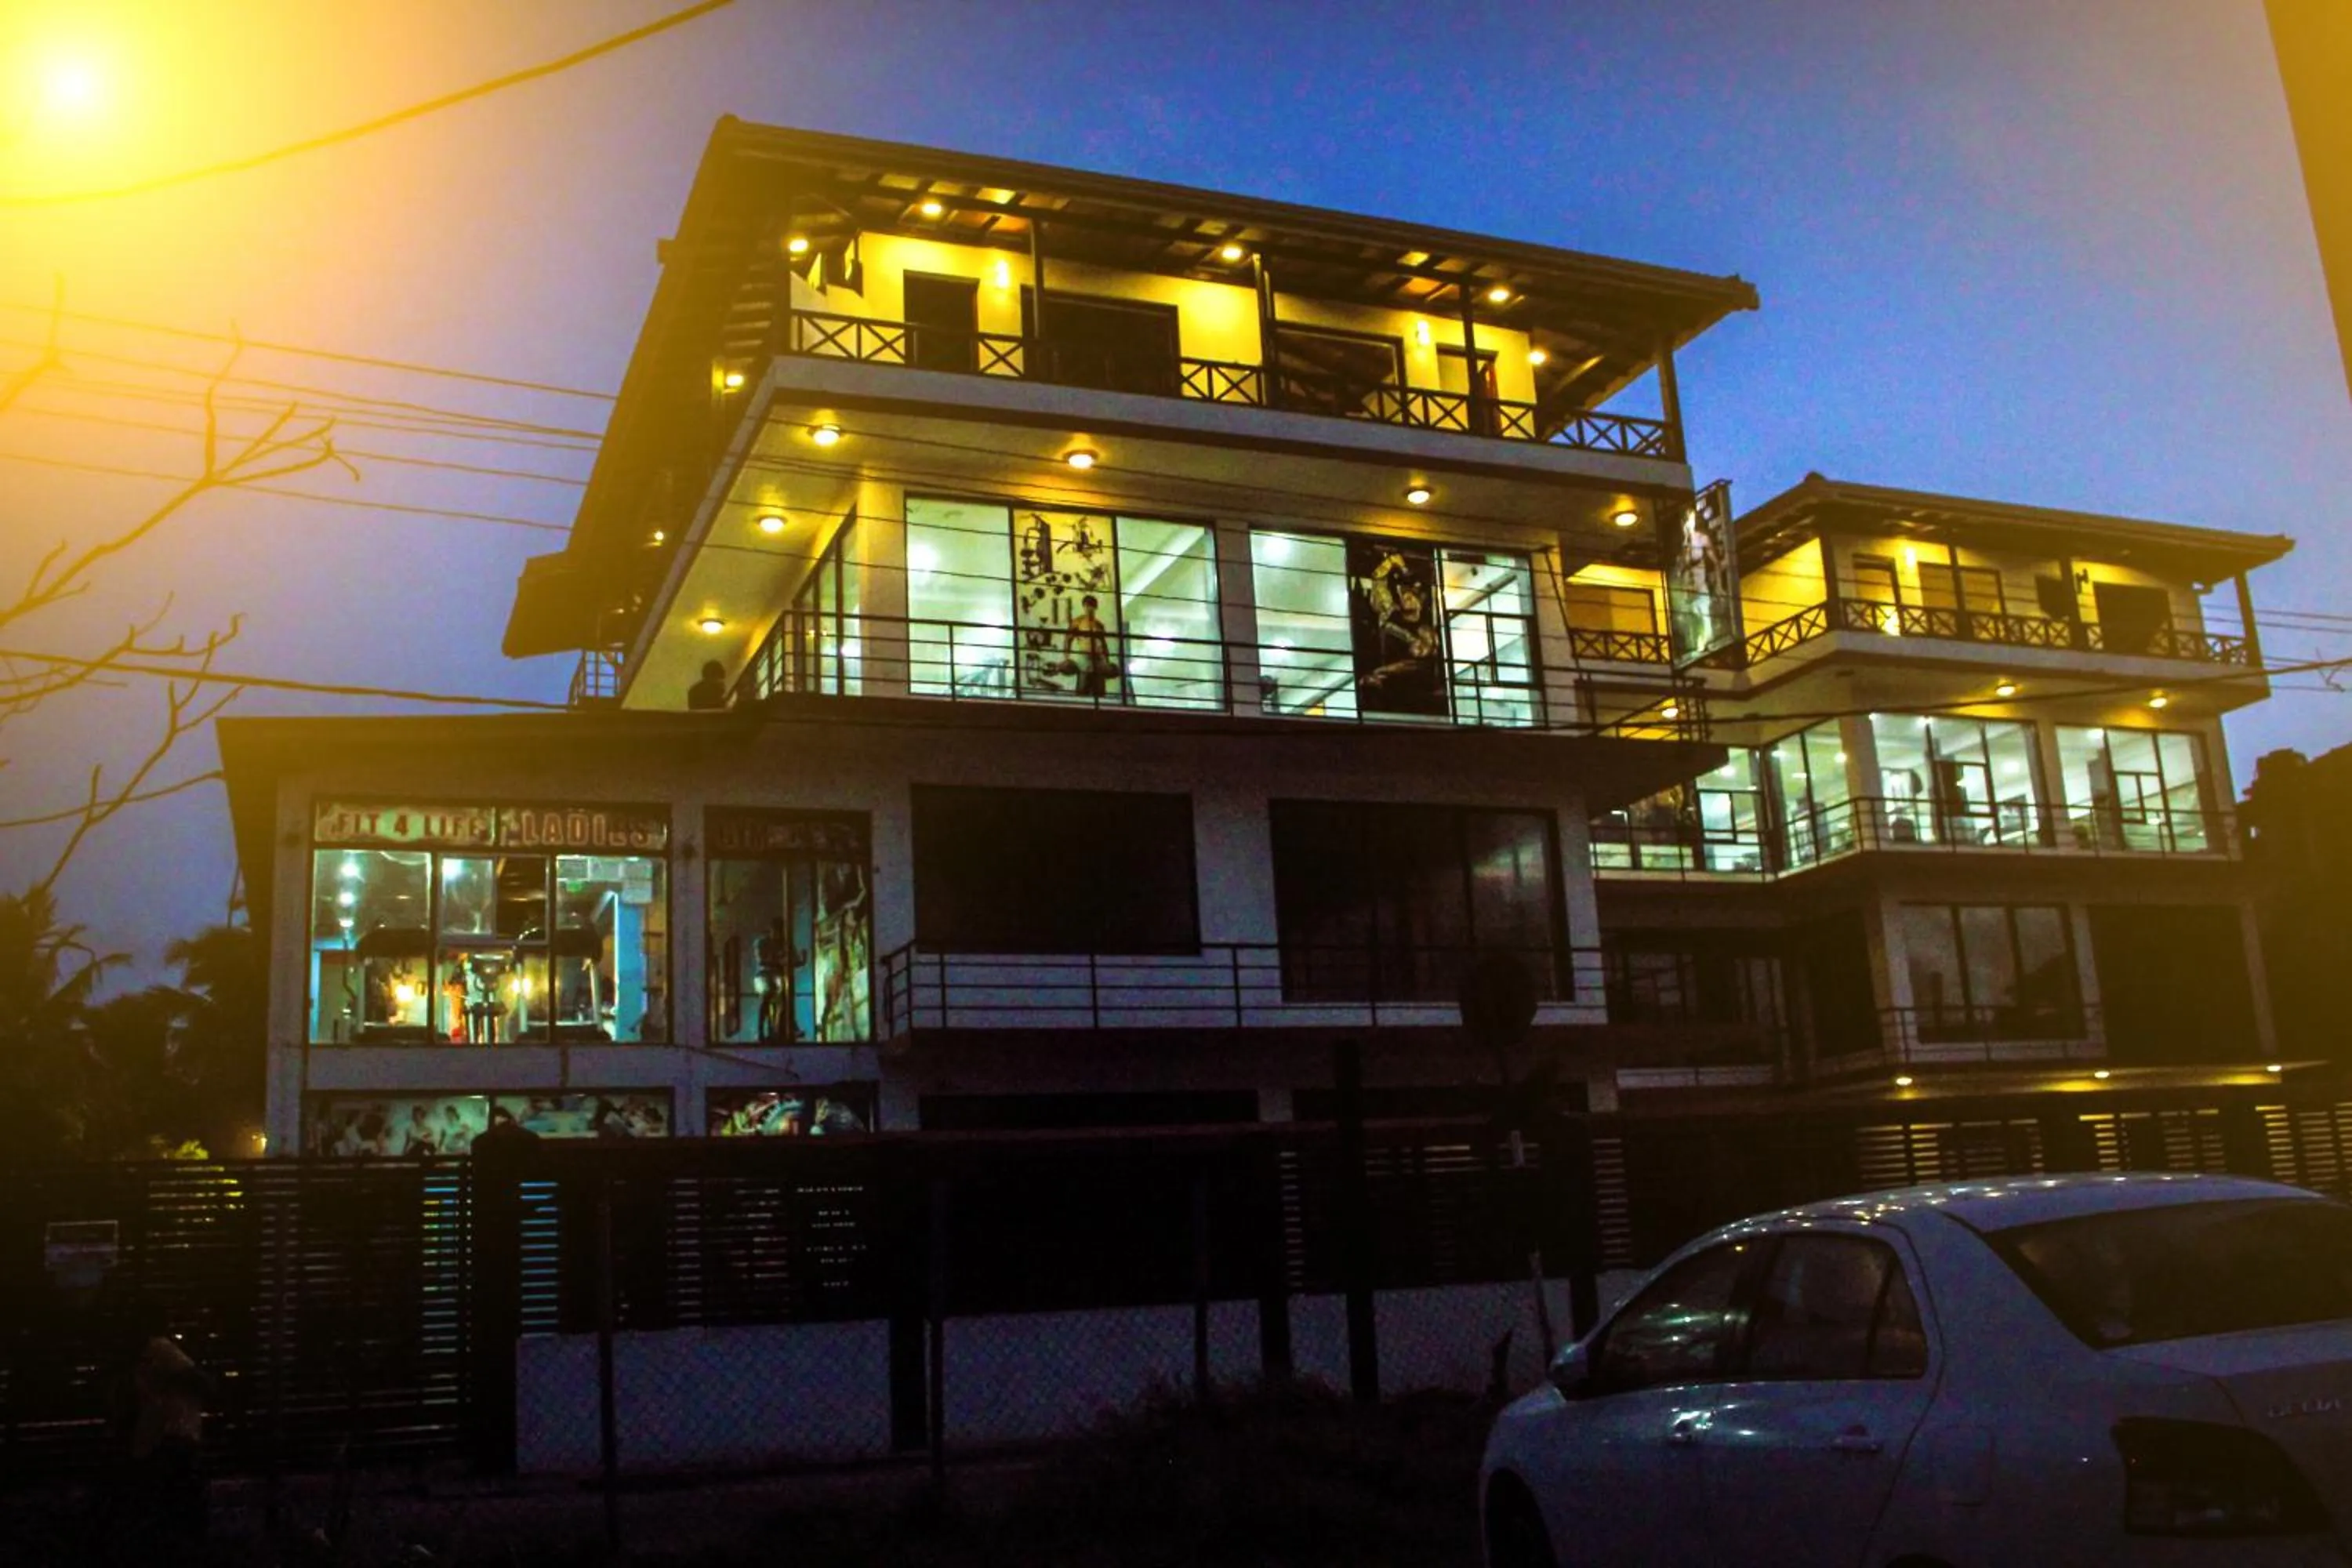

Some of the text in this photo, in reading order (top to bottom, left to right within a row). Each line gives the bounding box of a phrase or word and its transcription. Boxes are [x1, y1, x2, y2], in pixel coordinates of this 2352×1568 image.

[336, 812, 379, 834] FIT
[394, 814, 408, 836] 4
[423, 814, 481, 839] LIFE
